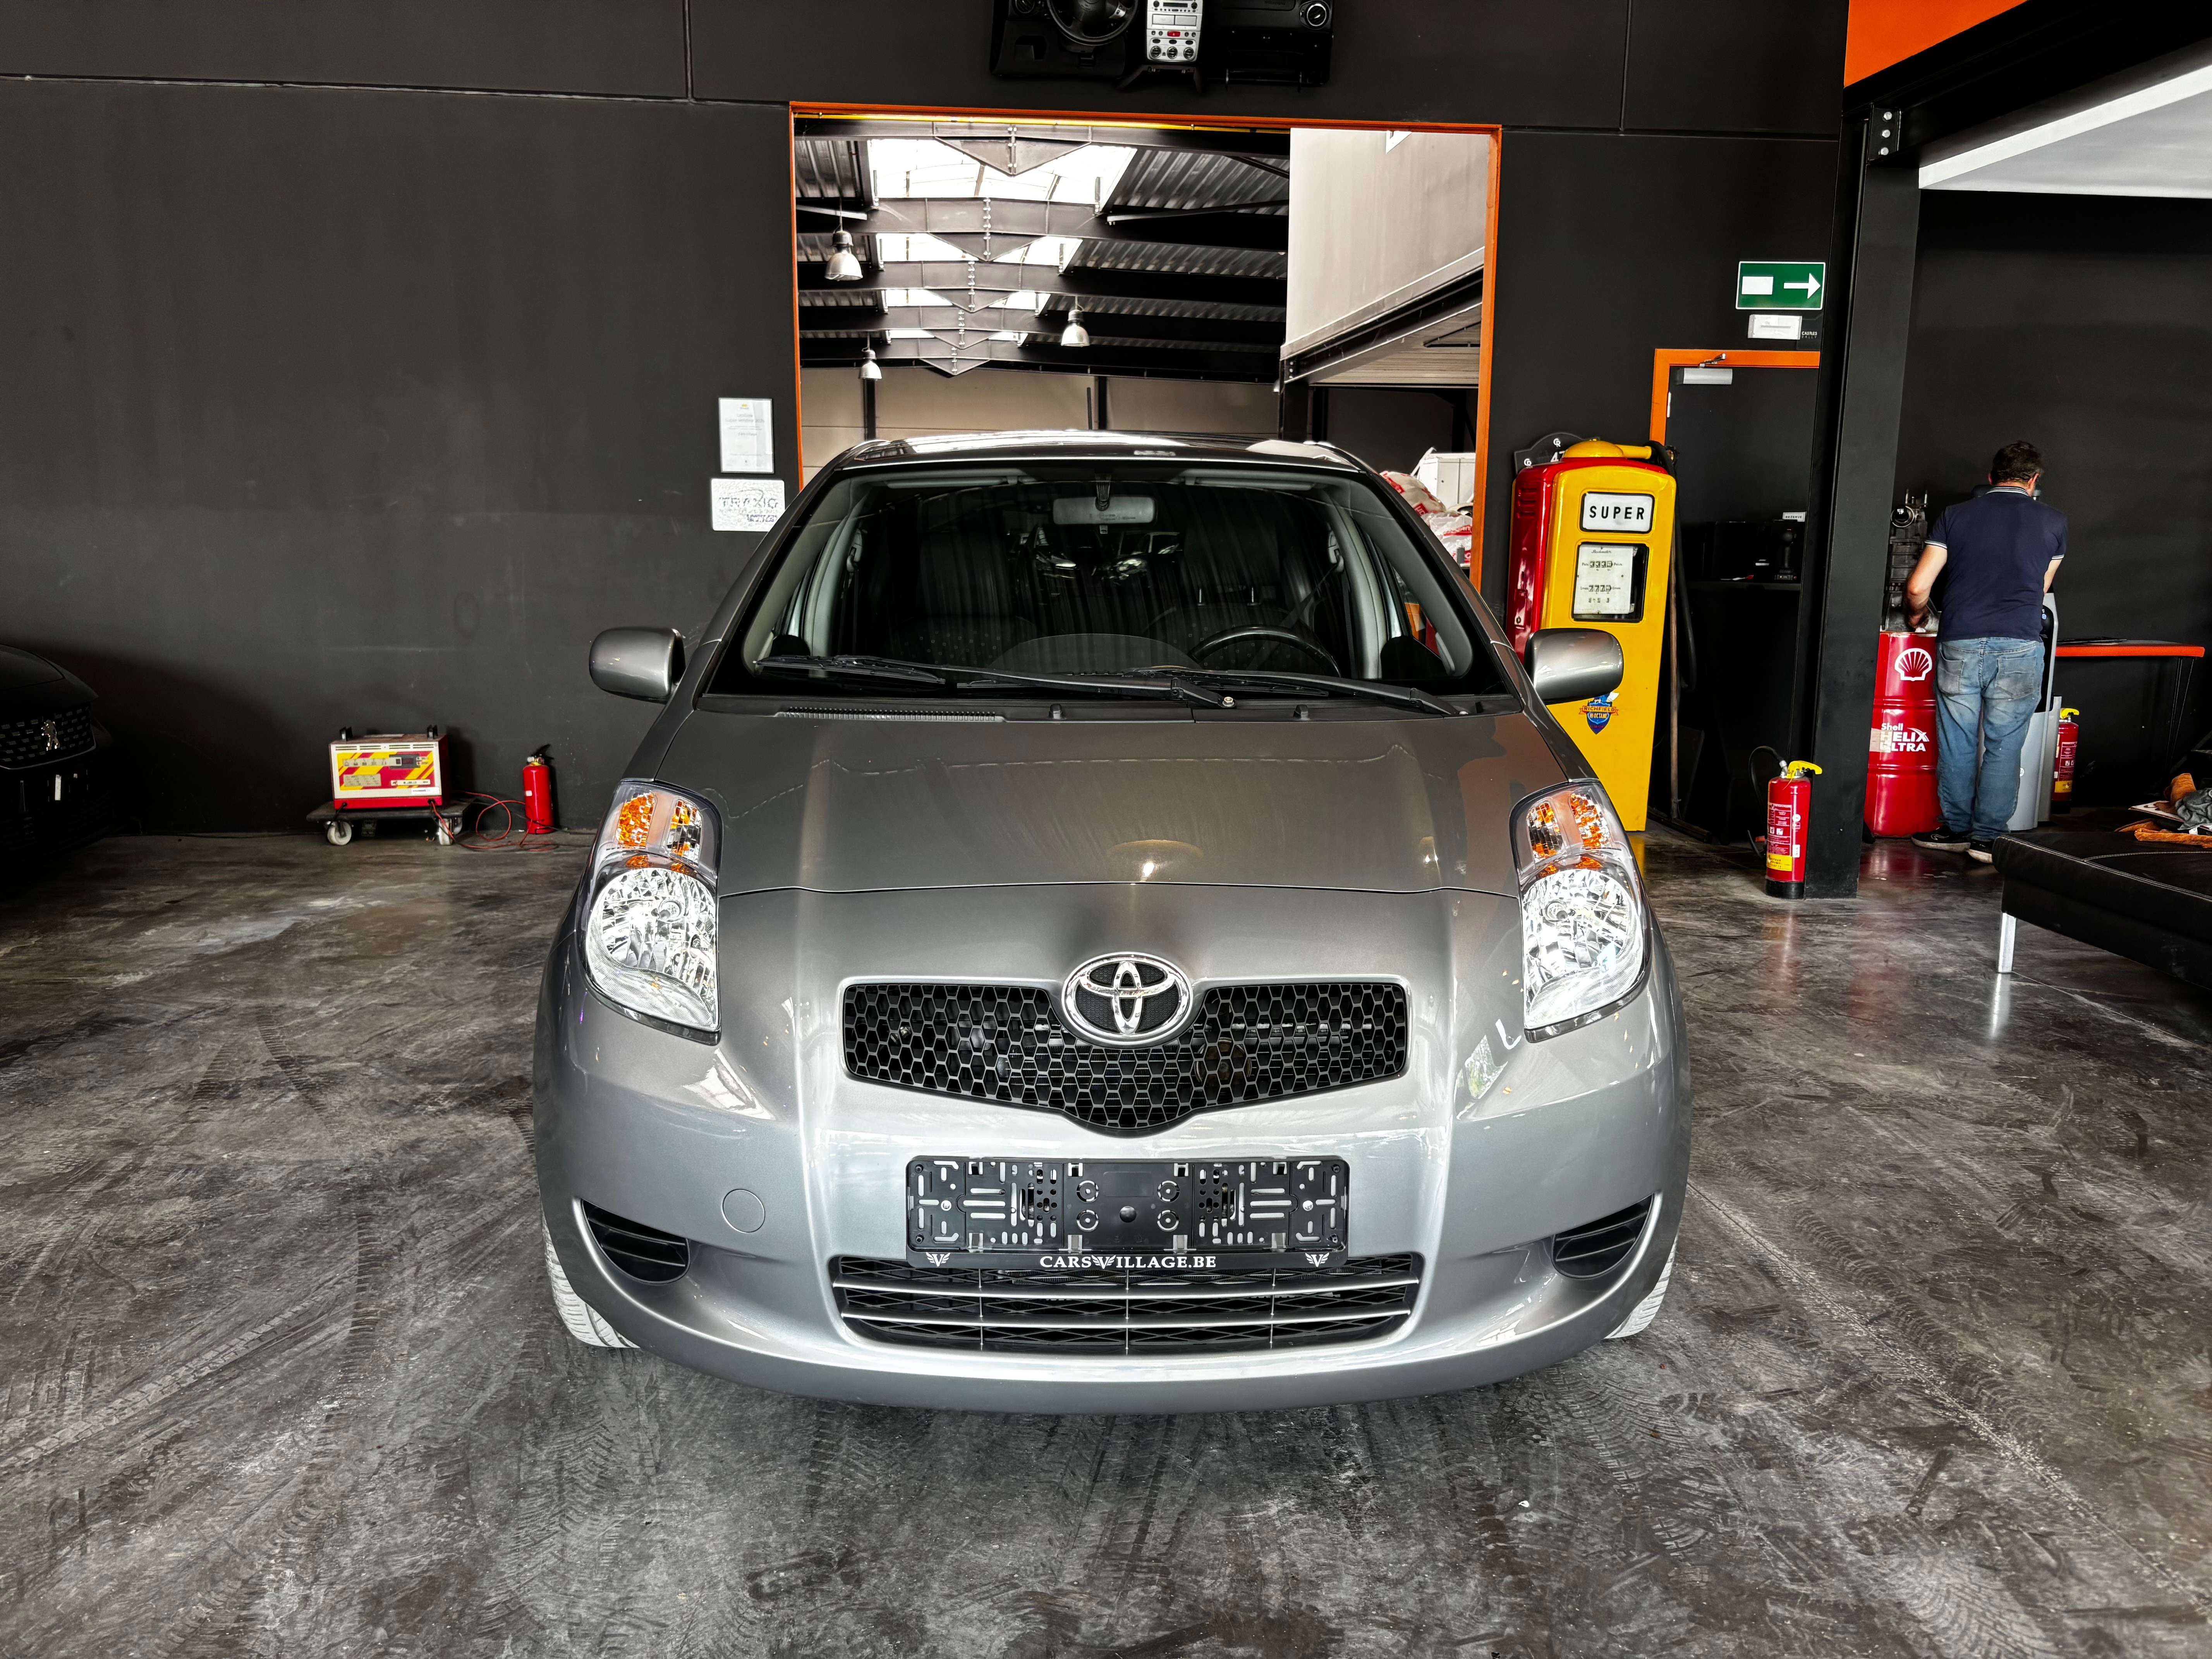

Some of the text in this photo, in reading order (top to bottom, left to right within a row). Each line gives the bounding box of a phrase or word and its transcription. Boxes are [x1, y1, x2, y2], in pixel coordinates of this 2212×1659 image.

[1589, 506, 1644, 520] SUPER
[1881, 723, 1903, 731] Shell
[1040, 1254, 1216, 1269] CARSVILLAGE.BE
